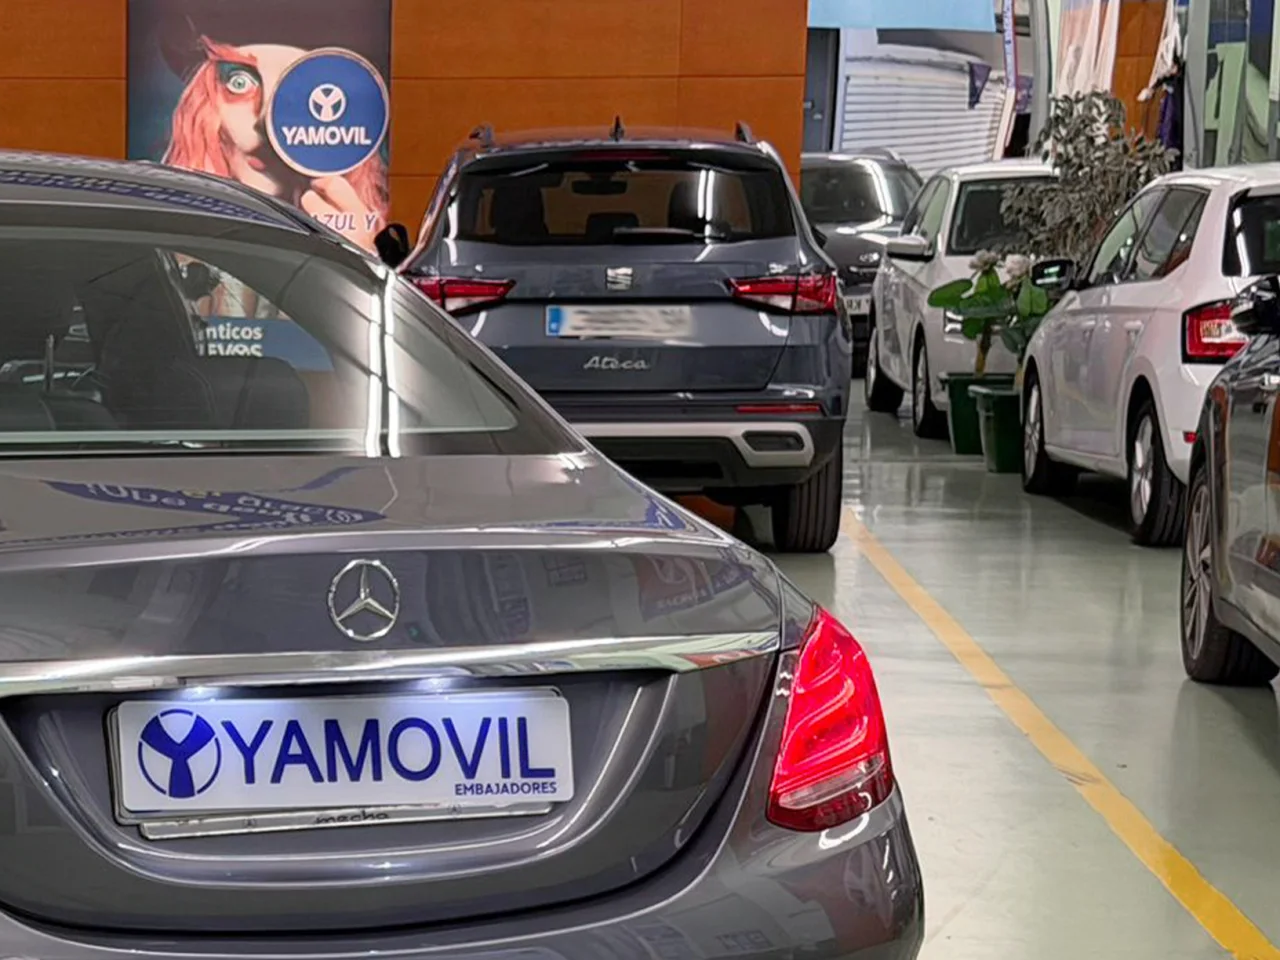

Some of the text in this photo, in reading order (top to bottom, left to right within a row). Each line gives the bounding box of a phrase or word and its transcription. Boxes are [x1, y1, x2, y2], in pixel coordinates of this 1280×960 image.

[282, 126, 372, 145] YAMOVIL
[583, 355, 649, 370] Ateca
[220, 717, 556, 785] YAMOVIL
[455, 782, 557, 797] EMBAJADORES
